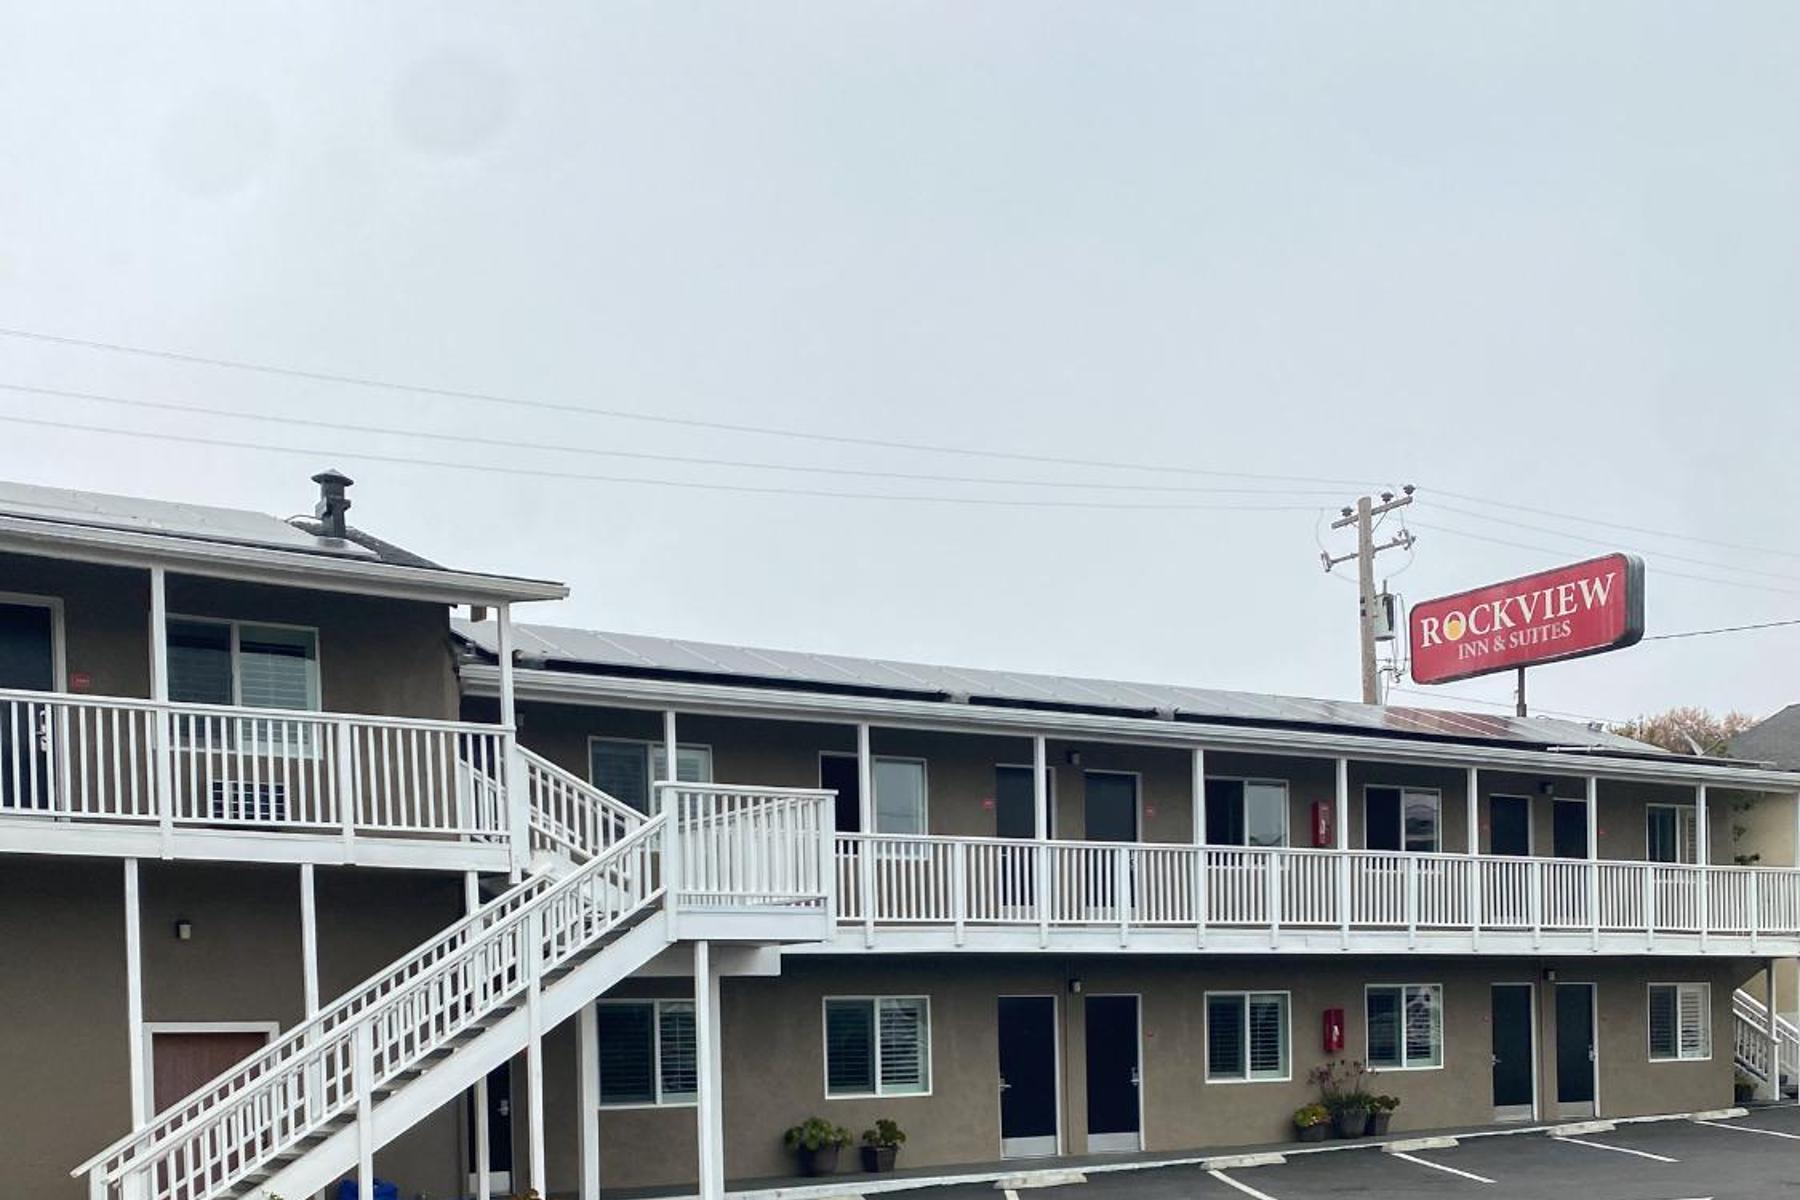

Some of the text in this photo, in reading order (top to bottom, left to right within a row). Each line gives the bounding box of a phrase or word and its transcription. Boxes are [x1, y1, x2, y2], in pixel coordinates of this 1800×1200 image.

[1420, 572, 1616, 648] ROCKVIEW
[1458, 620, 1572, 660] INN & SUITES
